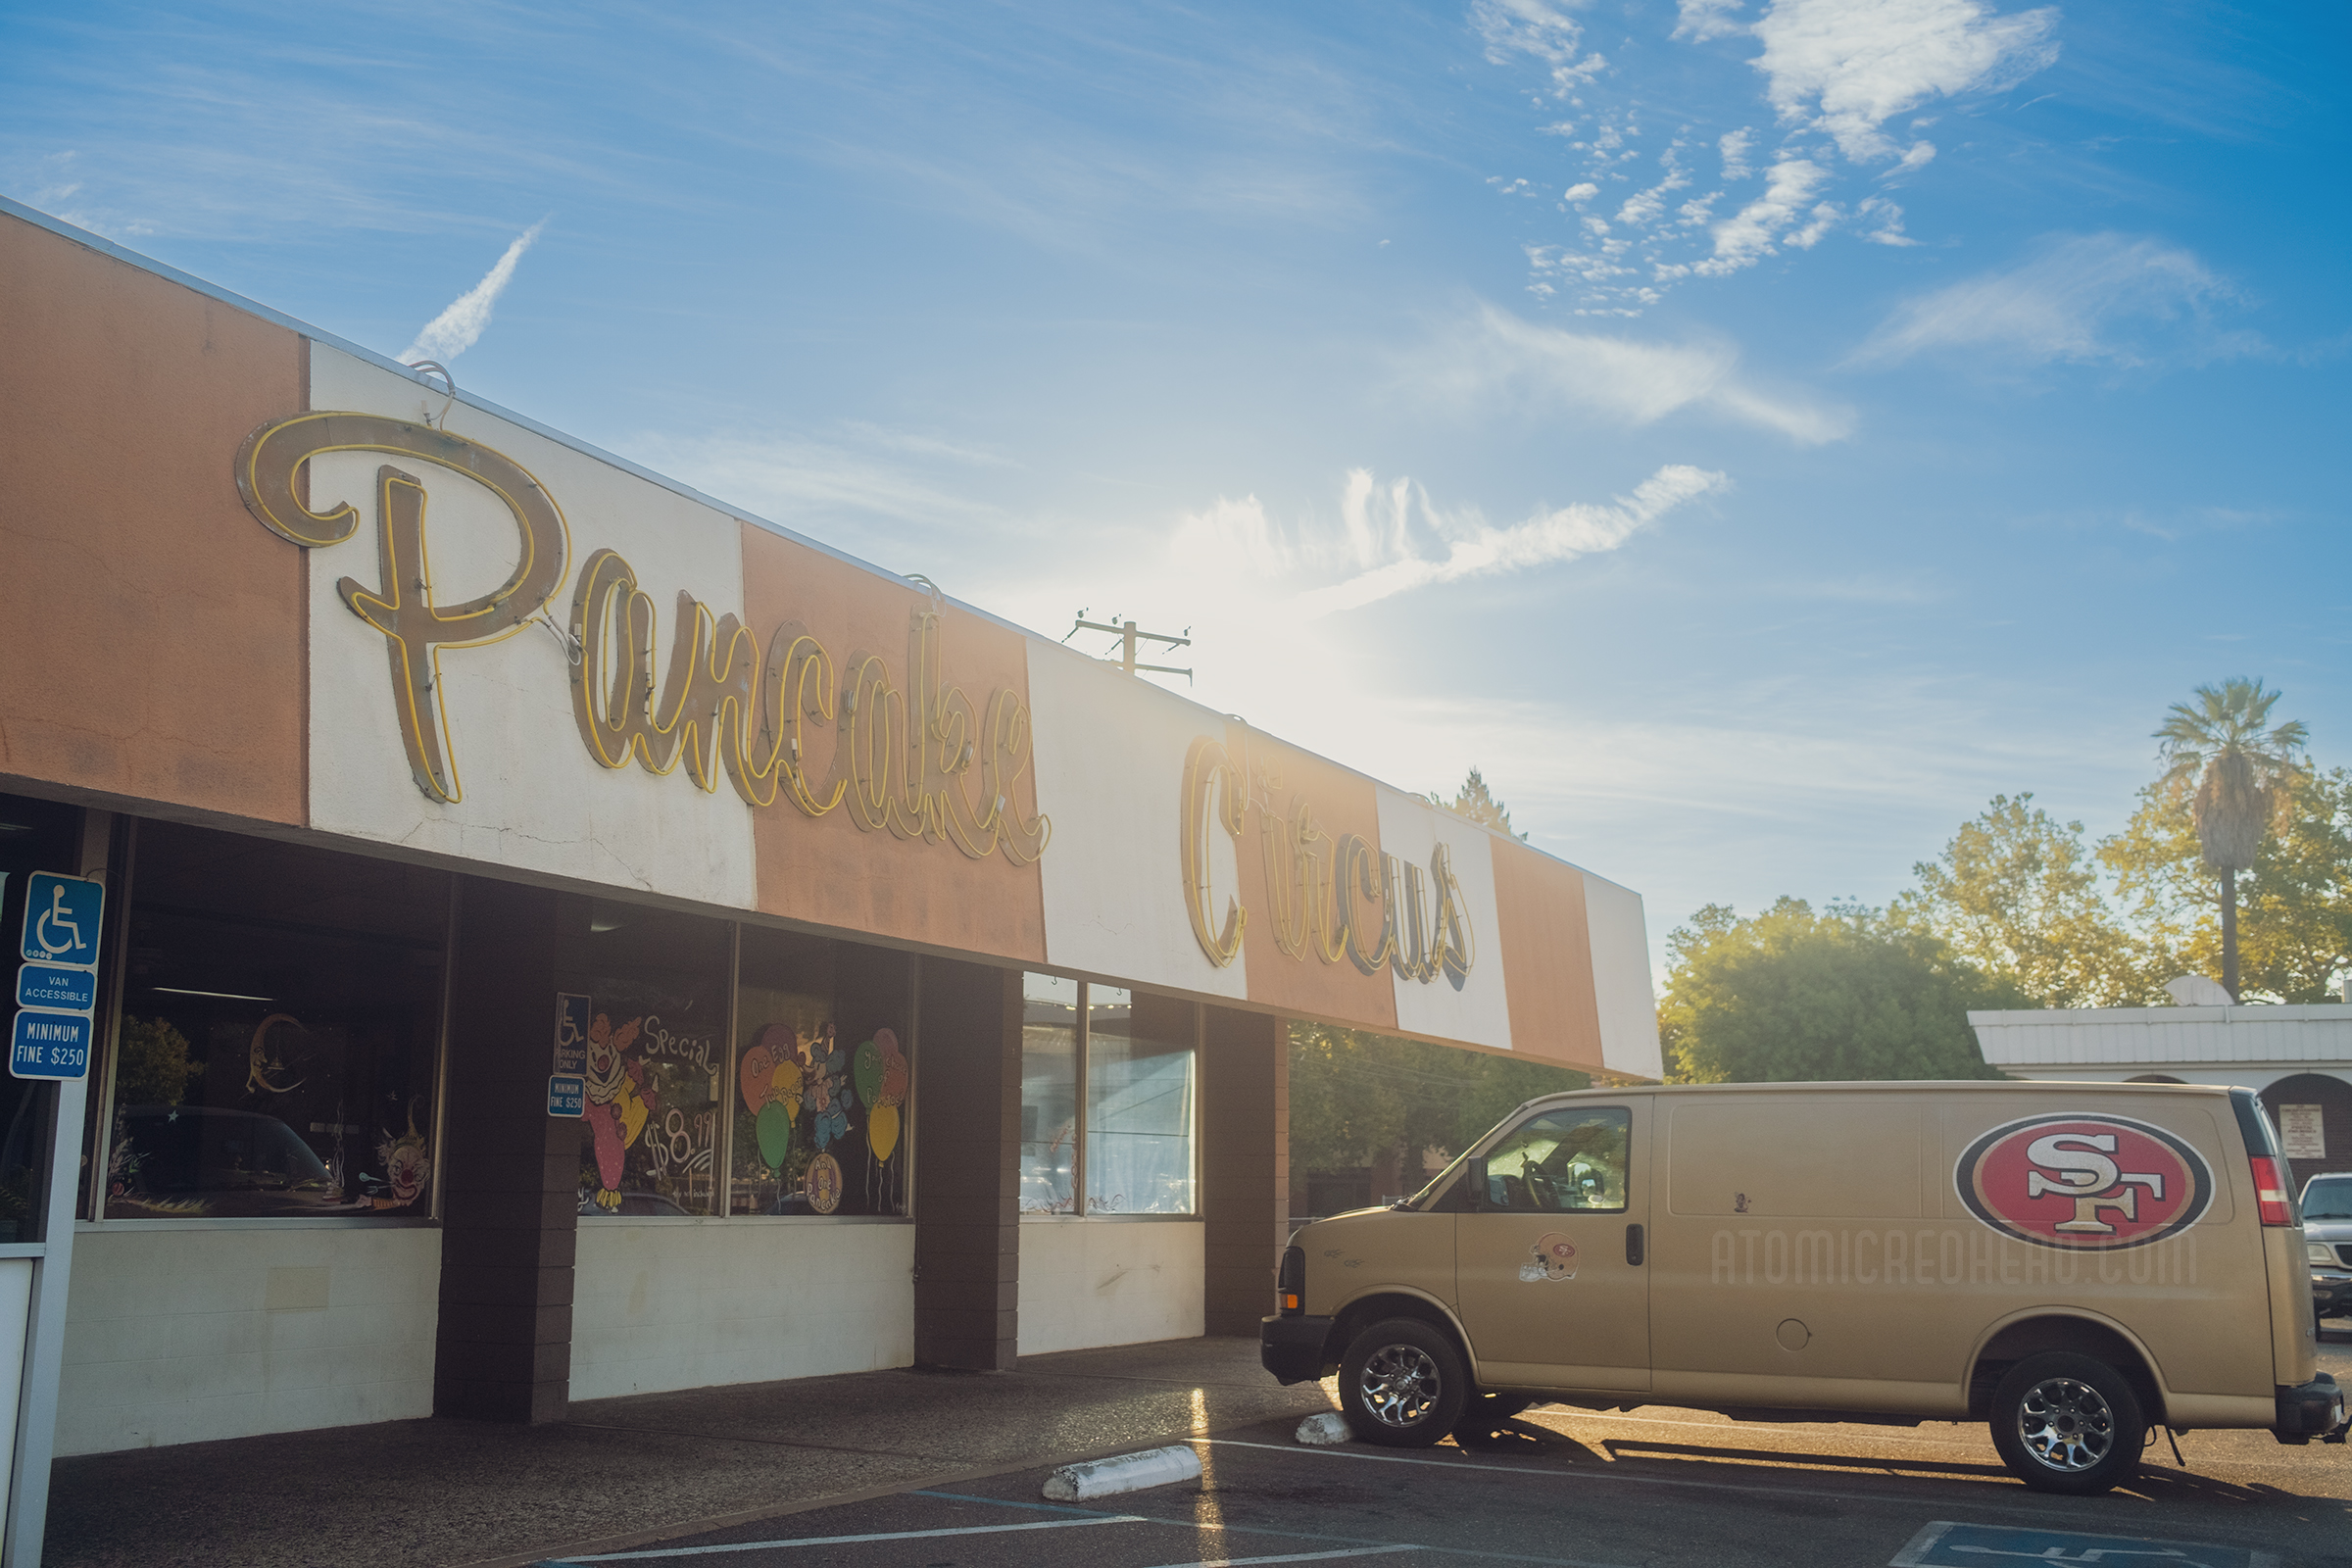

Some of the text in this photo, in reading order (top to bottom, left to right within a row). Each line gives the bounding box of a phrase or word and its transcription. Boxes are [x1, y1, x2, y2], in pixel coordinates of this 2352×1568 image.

[235, 411, 1475, 992] Pancake Circus
[49, 976, 69, 987] VAN
[25, 988, 88, 1002] ACCESSIBLE
[26, 1023, 79, 1042] MINIMUM
[17, 1045, 84, 1065] FINE $250
[555, 1049, 586, 1059] PARKING
[560, 1059, 578, 1070] ONLY
[555, 1083, 579, 1094] MINIMUM
[551, 1096, 582, 1108] FINE $250
[645, 1108, 713, 1182] $8.99
[2027, 1133, 2166, 1236] SF
